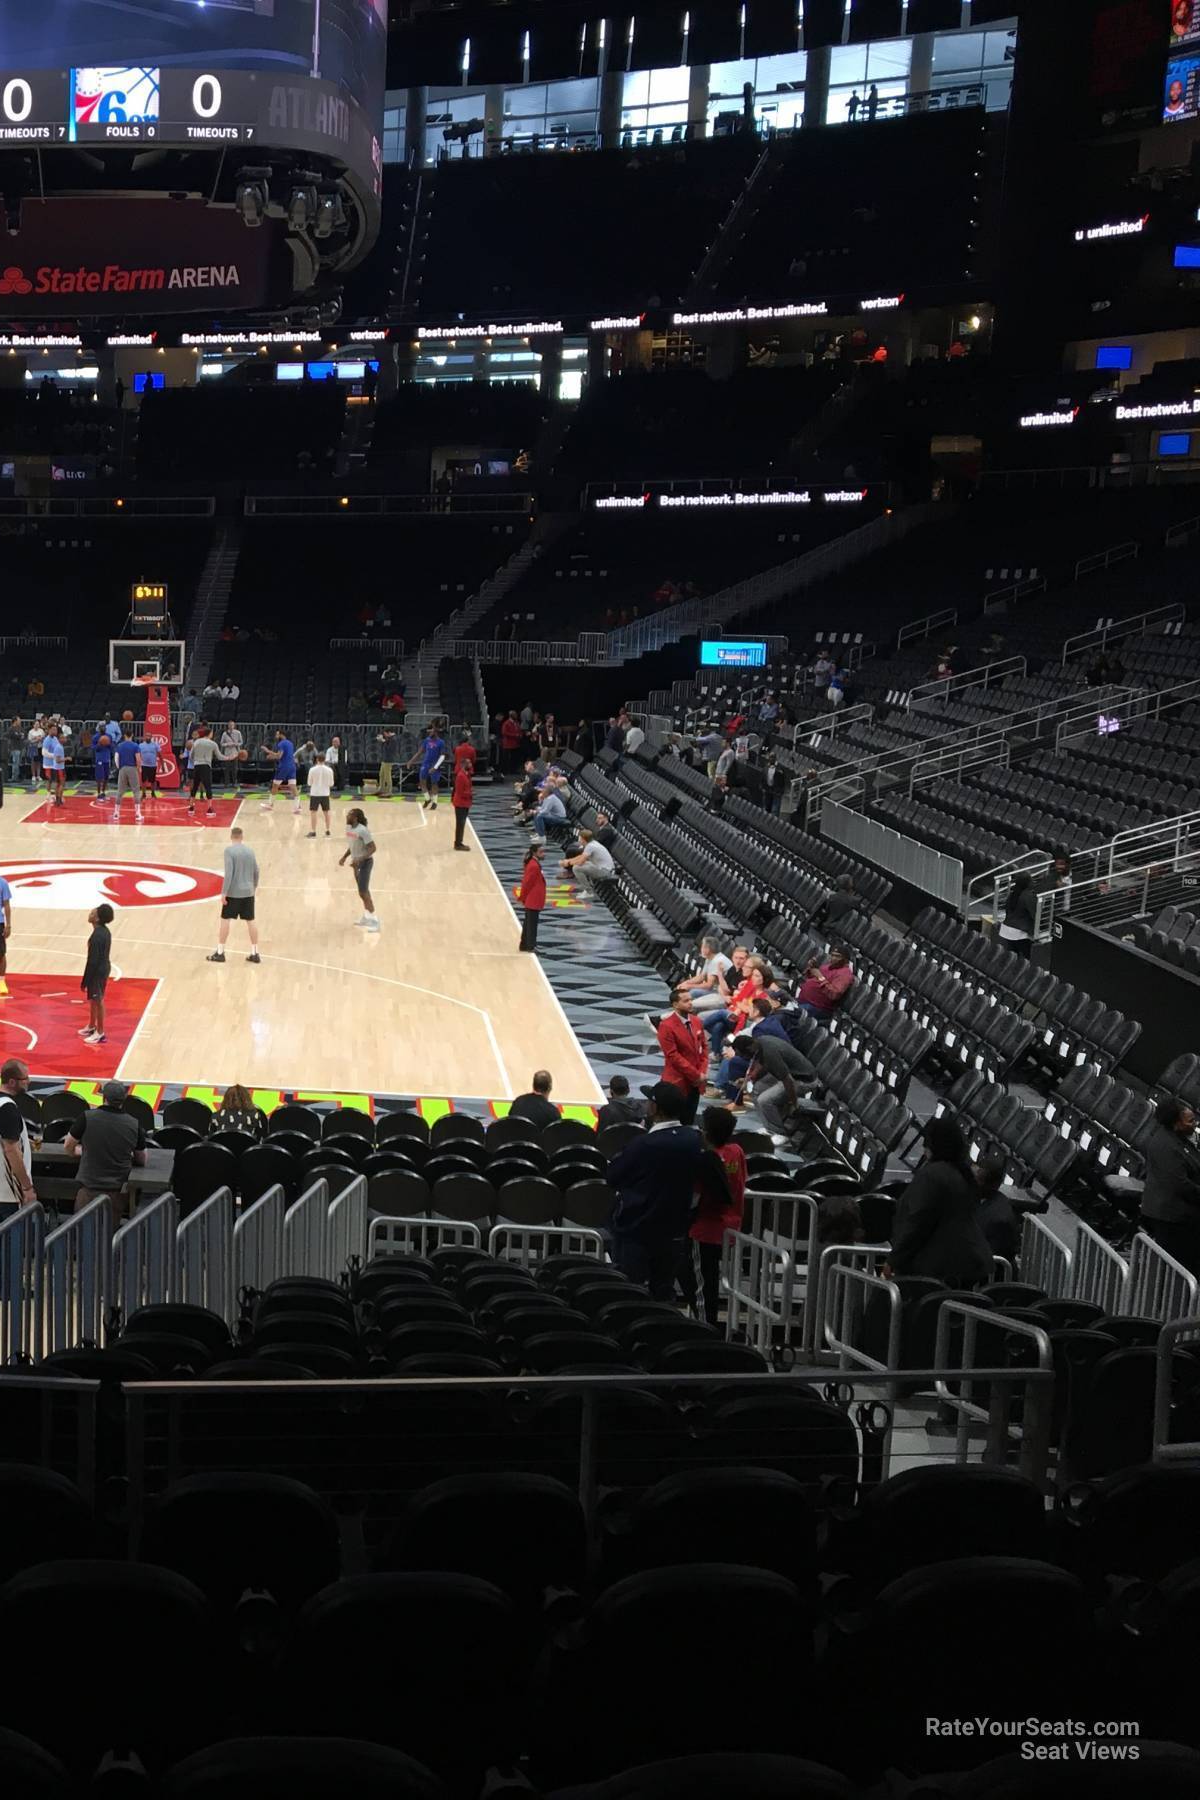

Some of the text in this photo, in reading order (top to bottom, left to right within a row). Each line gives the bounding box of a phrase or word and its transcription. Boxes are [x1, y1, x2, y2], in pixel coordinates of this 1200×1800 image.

[3, 78, 32, 122] 0
[193, 74, 222, 118] 0
[0, 128, 65, 138] TIMEOUTS 7
[106, 127, 155, 137] FOULS 0
[187, 127, 253, 138] TIMEOUTS 7
[1087, 219, 1143, 238] unlimited
[168, 265, 240, 289] ARENA
[861, 297, 899, 309] verizon
[673, 302, 828, 324] Best network. Best unlimited.
[591, 316, 640, 329] unlimited
[350, 330, 385, 340] verizon
[418, 321, 563, 337] Best network. Best unlimited.
[12, 335, 35, 345] Best
[35, 335, 82, 345] unlimited.
[107, 335, 152, 345] unlimited
[182, 331, 321, 343] Best network. Best unlimited.
[1116, 405, 1142, 419] Best
[1142, 401, 1193, 417] network.
[1021, 411, 1074, 426] unlimited
[596, 496, 644, 507] unlimited
[660, 491, 811, 506] Best network. Best unlimited.
[825, 491, 862, 501] verizon
